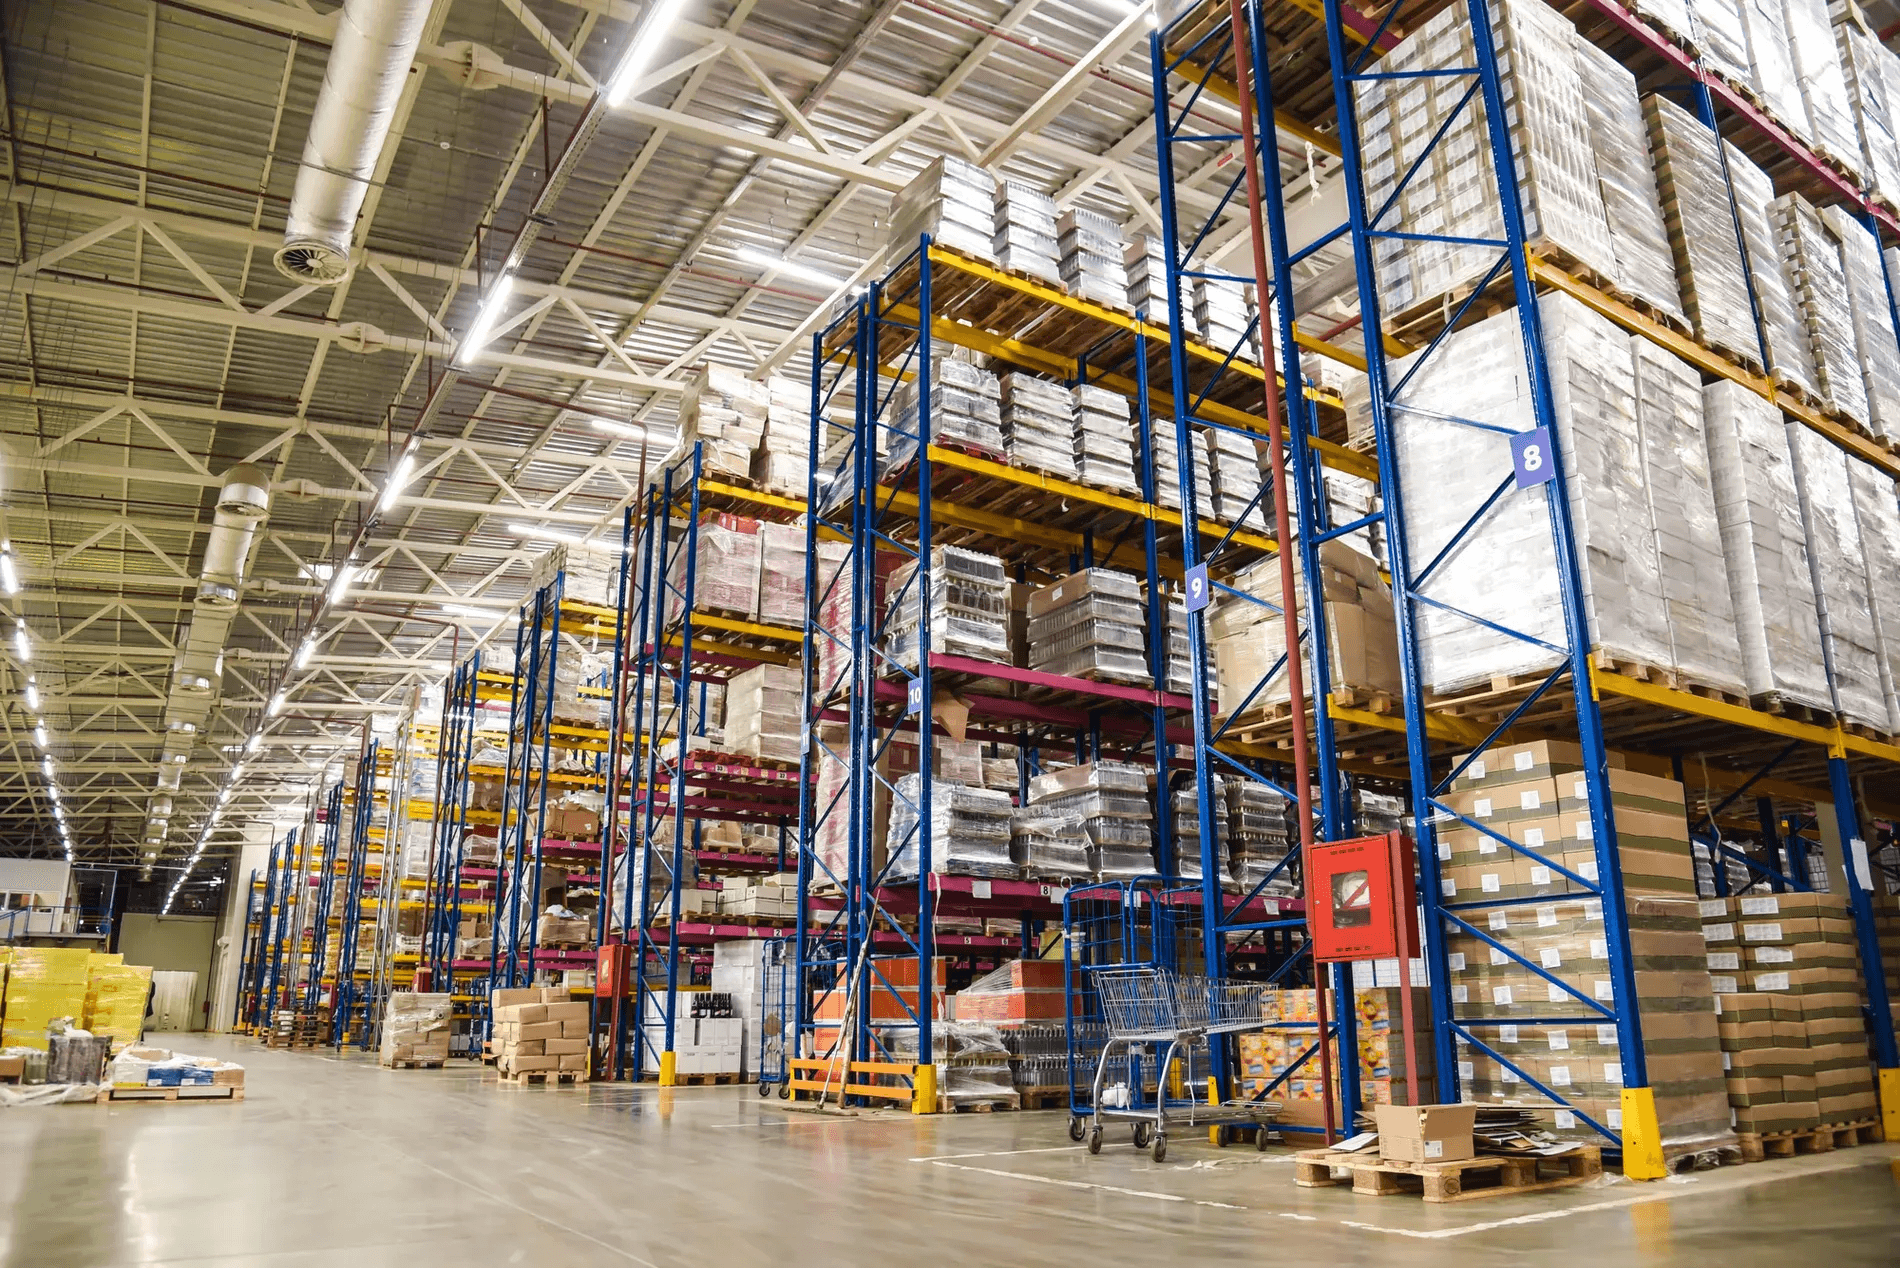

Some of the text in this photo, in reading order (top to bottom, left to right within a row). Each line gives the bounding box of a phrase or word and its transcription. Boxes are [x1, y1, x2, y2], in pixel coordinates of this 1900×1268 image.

[1523, 444, 1543, 472] 8
[1191, 577, 1202, 599] 9
[909, 686, 921, 705] 10
[1043, 886, 1049, 895] 8
